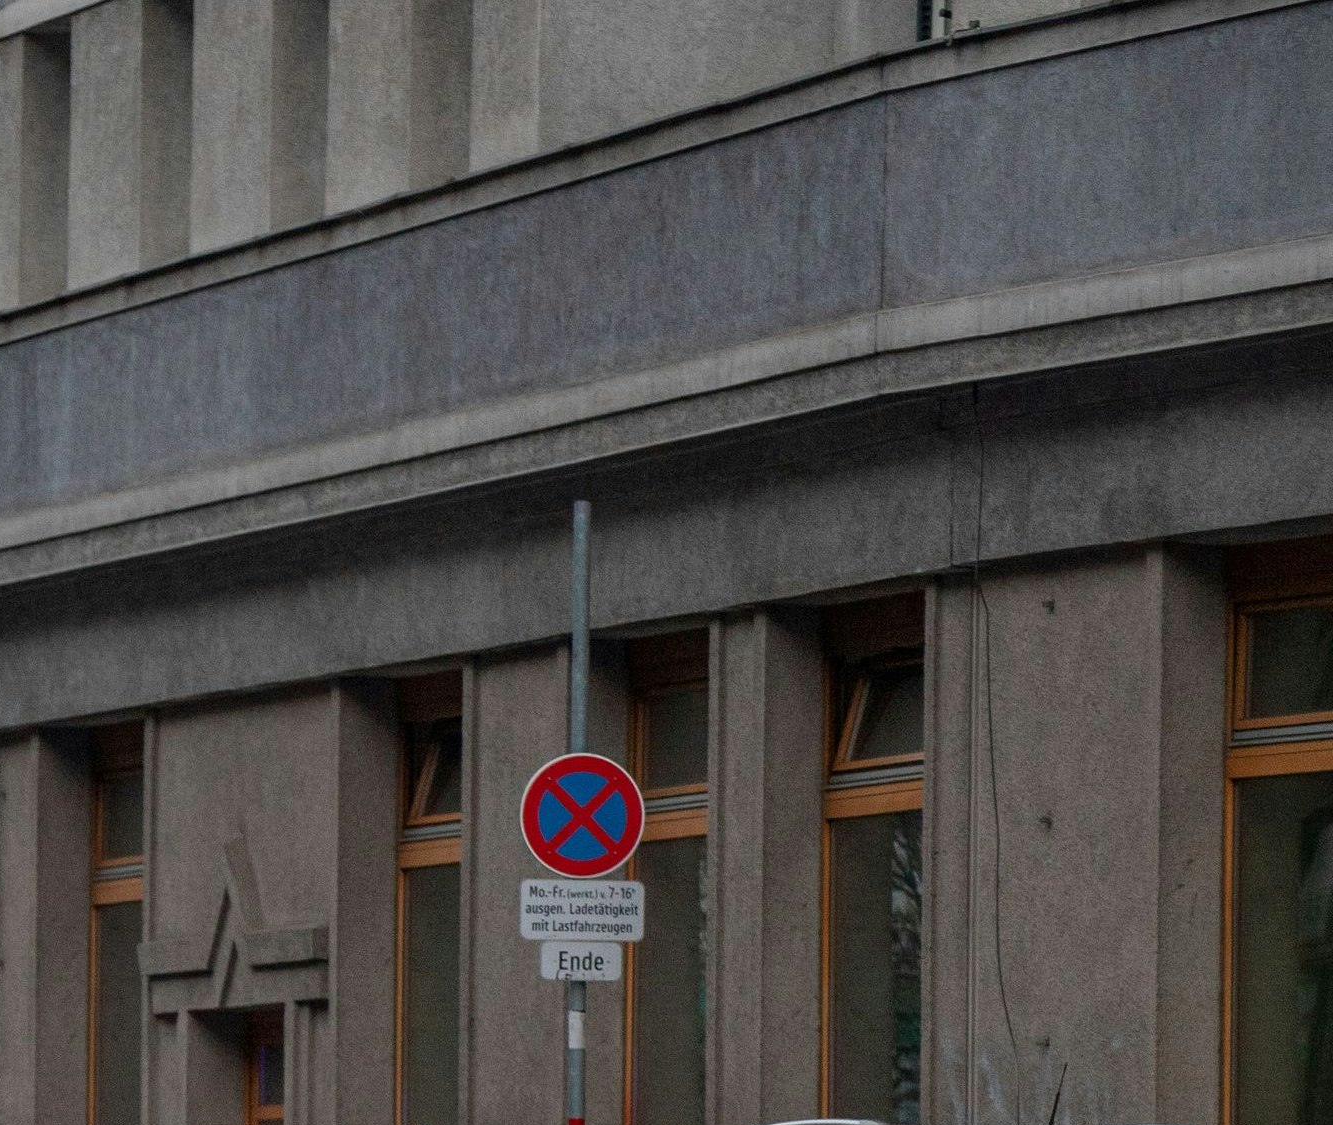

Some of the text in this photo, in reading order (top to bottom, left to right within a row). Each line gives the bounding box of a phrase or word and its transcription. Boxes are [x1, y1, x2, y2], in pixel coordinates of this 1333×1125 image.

[529, 885, 566, 898] Mo.-Fr.
[567, 889, 598, 899] (werkt.)
[525, 903, 639, 918] ausgen. Ladetätigkeit
[531, 919, 633, 936] mit Lastfahrzeugen
[559, 951, 604, 971] Ende
